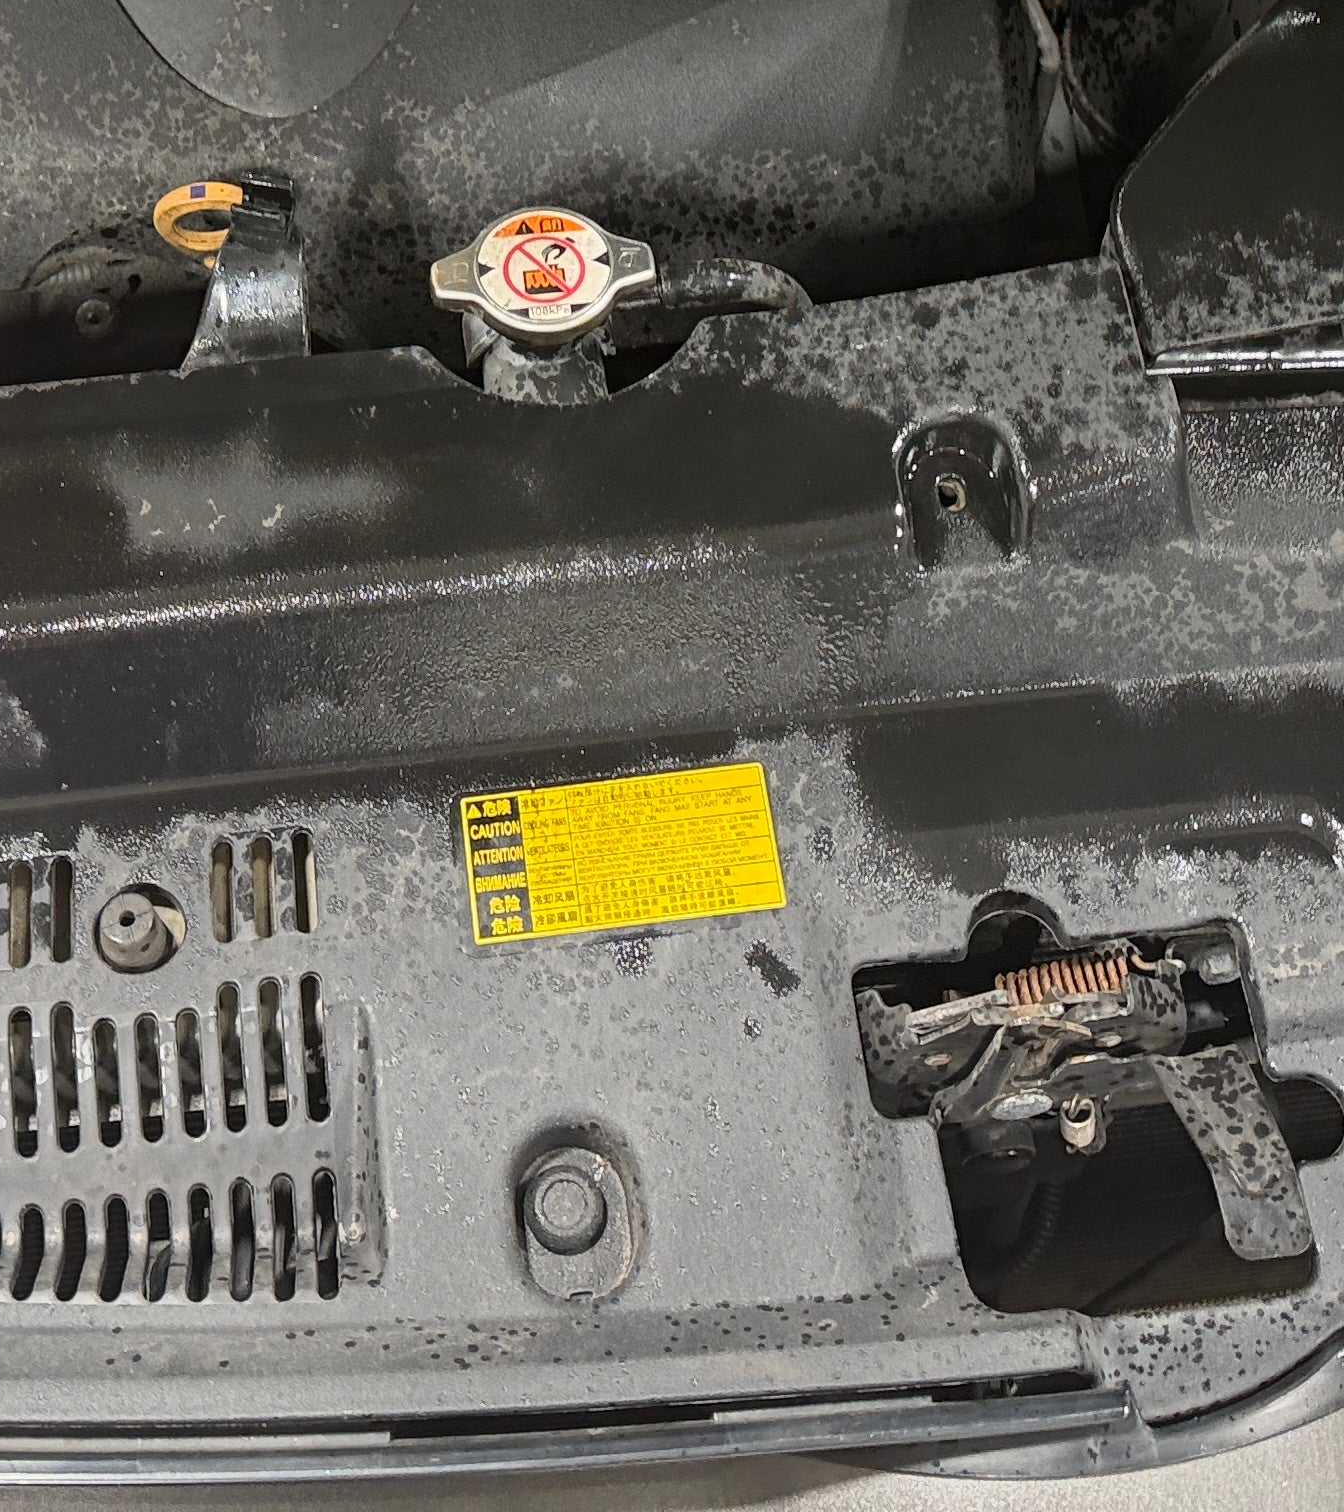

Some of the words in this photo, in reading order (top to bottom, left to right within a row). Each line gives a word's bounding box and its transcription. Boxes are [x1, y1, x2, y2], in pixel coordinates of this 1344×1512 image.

[482, 799, 512, 818] 危険
[470, 820, 520, 840] CAUTION
[552, 818, 566, 827] FANS
[473, 846, 523, 866] ATTENTION
[475, 872, 527, 893] ВНИМАНИЕ
[488, 894, 522, 915] 危险
